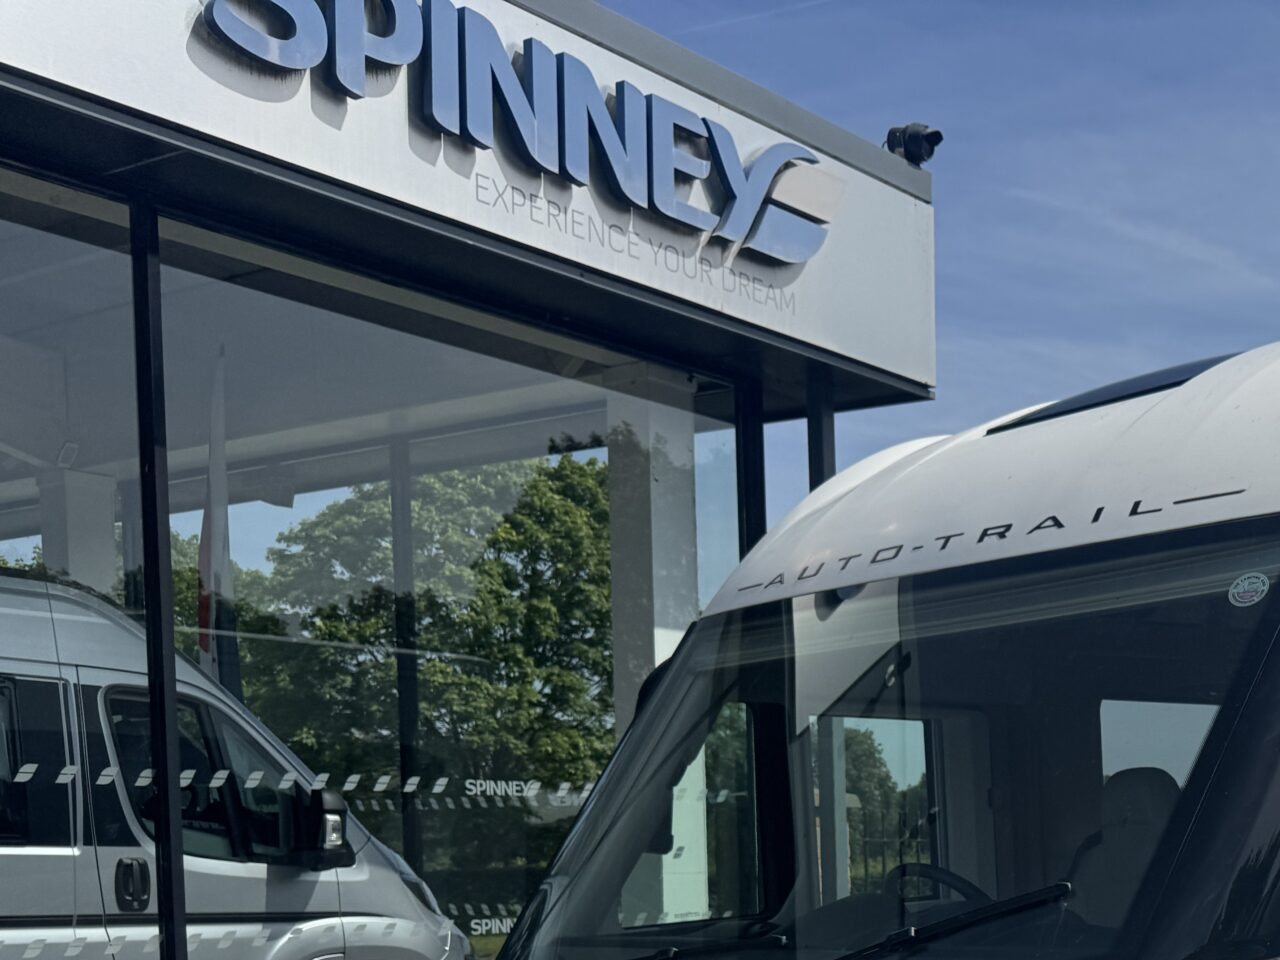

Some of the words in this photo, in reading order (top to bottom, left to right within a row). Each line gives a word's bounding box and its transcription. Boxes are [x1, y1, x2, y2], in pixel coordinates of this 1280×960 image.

[474, 172, 641, 261] EXPERIENCE
[647, 236, 714, 287] YOUR
[720, 264, 797, 316] DREAM
[464, 779, 535, 797] SPINNEY
